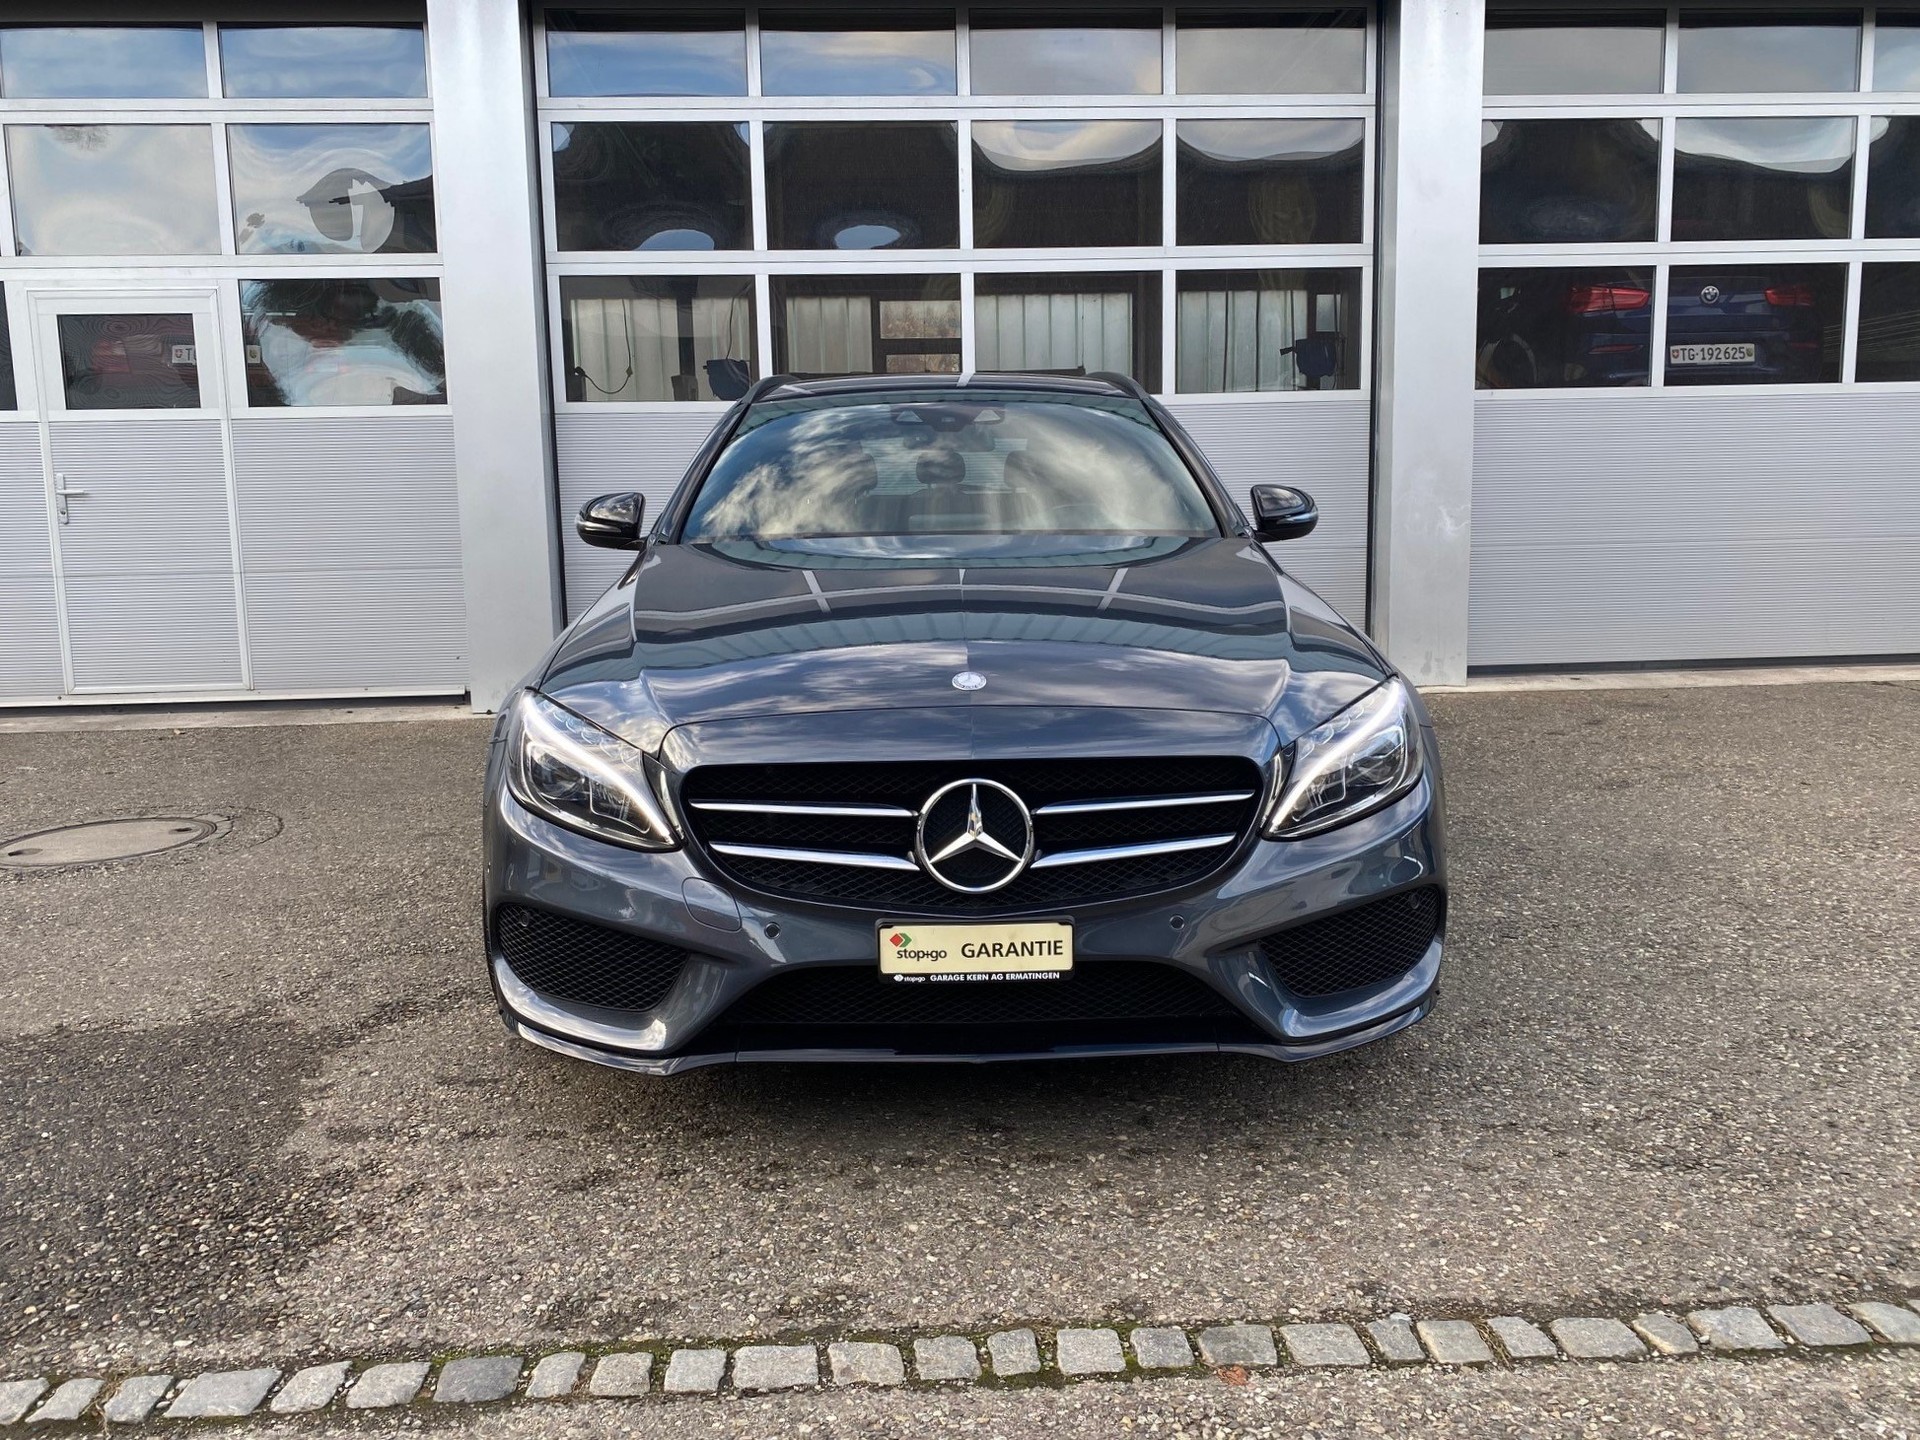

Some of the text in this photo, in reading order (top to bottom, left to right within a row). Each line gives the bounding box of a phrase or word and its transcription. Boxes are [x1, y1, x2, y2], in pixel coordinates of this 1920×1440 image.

[896, 948, 947, 962] stop+go
[961, 940, 1063, 959] GARANTIE
[930, 974, 964, 982] GARAGE
[966, 973, 989, 982] KERN
[991, 973, 1004, 981] AG
[1005, 972, 1060, 981] ERMATINGEN
